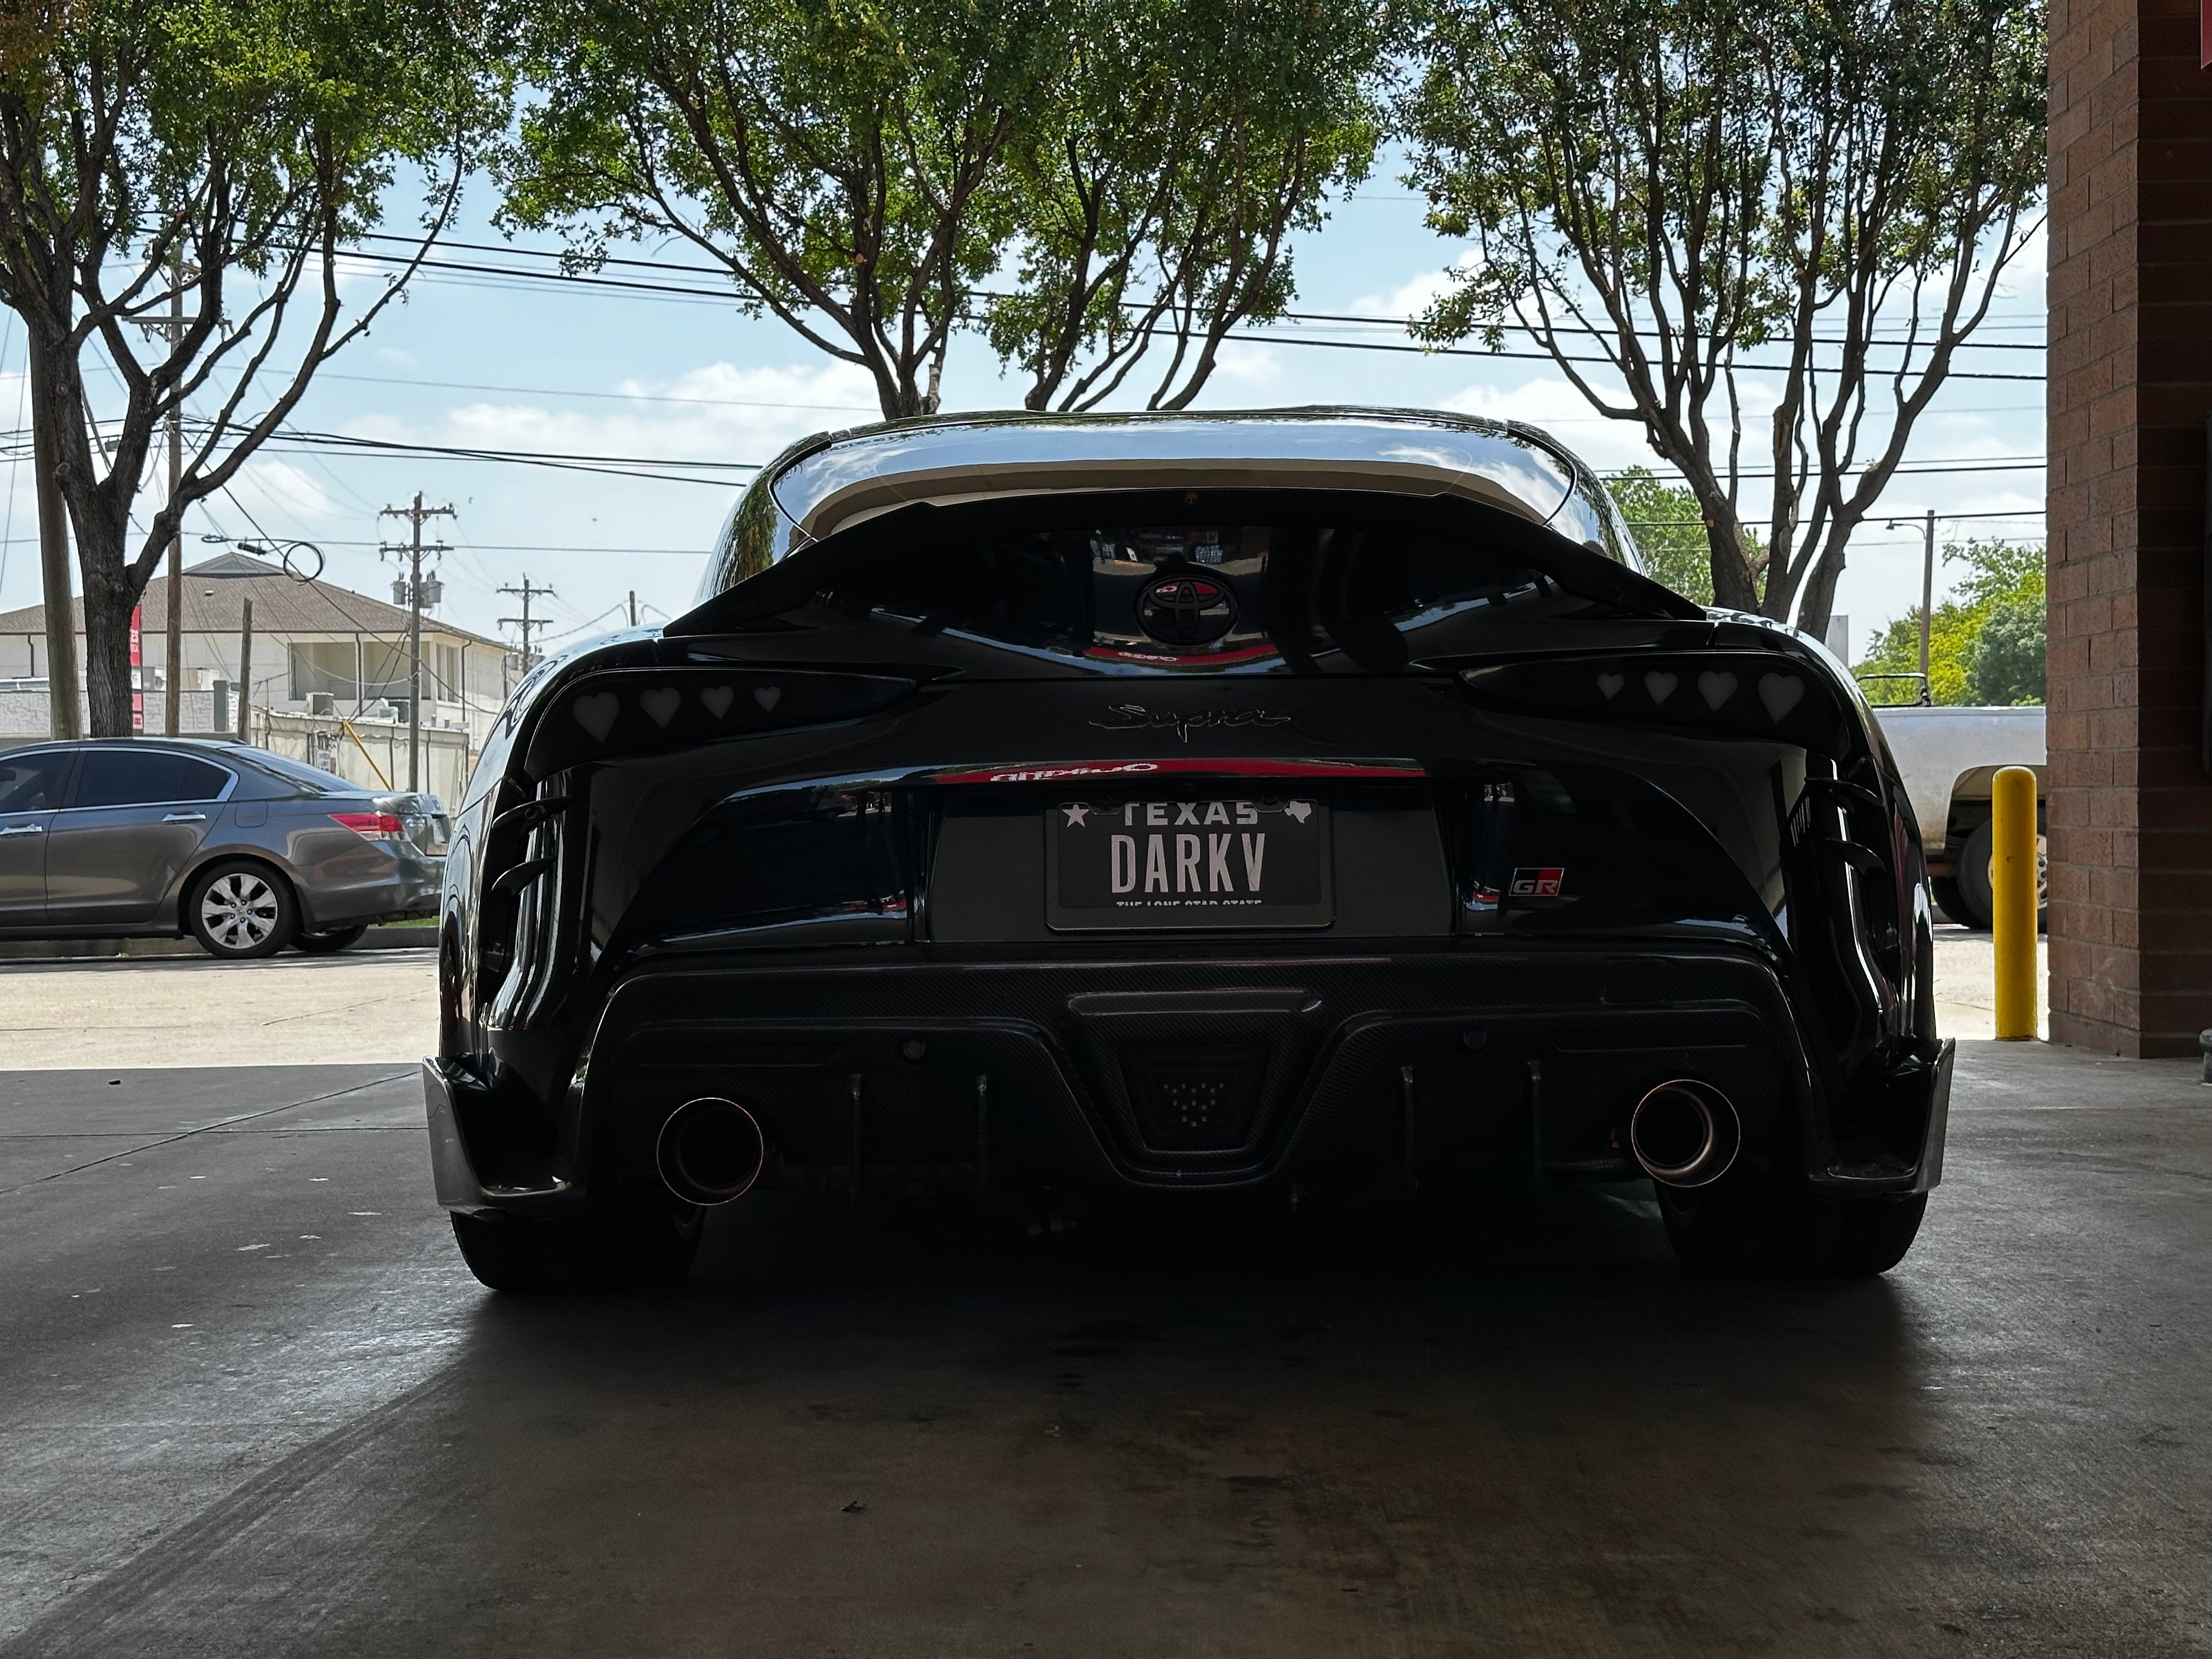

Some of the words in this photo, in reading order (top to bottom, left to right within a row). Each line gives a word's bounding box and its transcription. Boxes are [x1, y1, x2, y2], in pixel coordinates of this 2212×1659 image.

[1125, 802, 1259, 826] TEXAS
[1111, 833, 1266, 893] DARKV
[1513, 879, 1559, 894] GR
